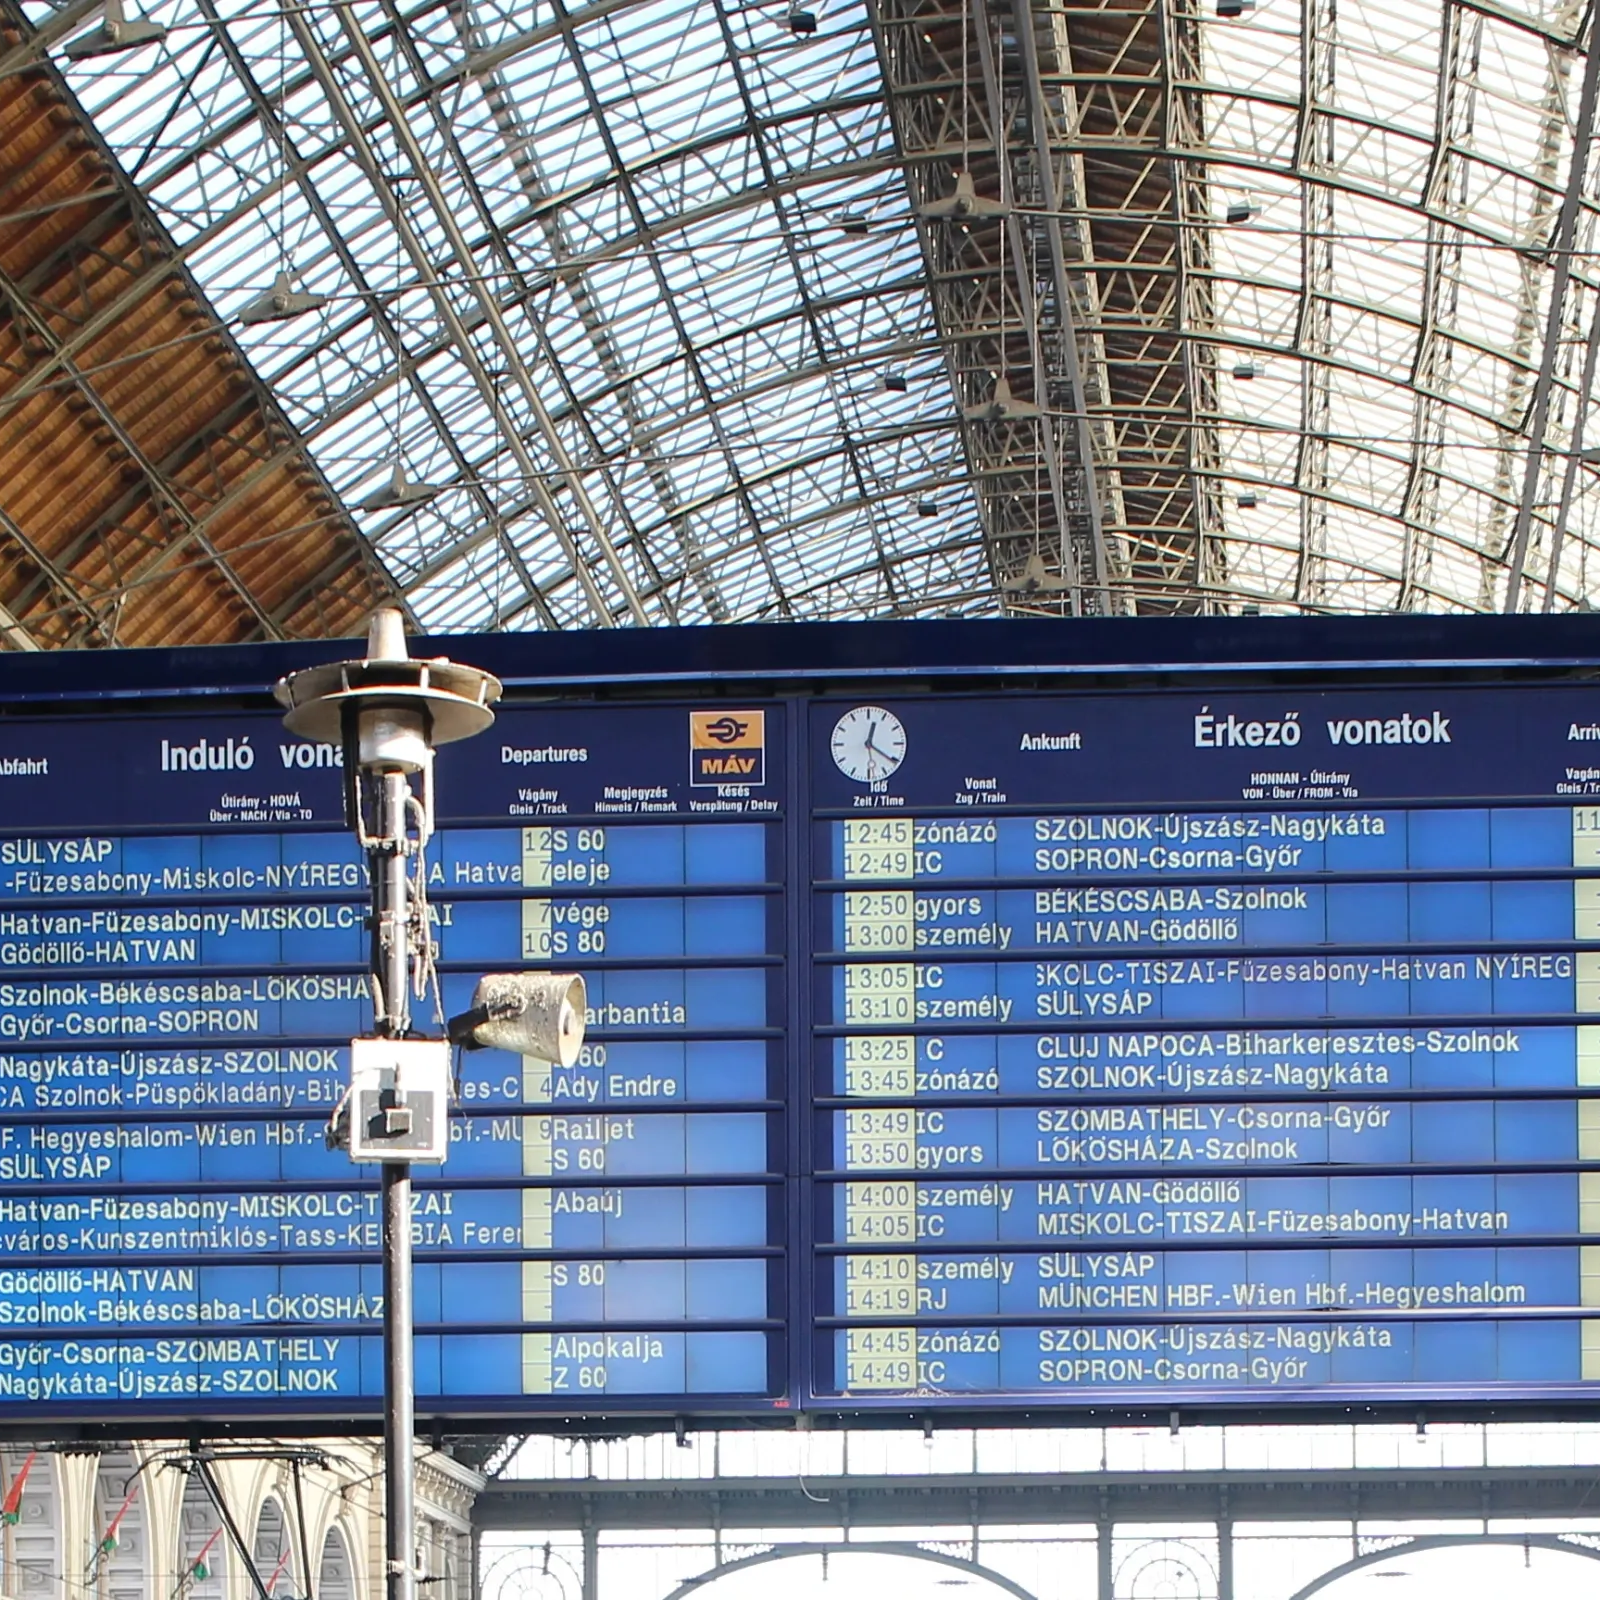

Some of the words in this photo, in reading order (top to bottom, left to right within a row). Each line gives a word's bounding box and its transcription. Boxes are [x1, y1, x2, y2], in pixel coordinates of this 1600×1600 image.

[1194, 706, 1301, 748] Érkező
[1326, 711, 1451, 745] vonatok
[1019, 732, 1082, 751] Ankunft
[161, 736, 255, 772] Induló
[500, 746, 588, 766] Departures
[701, 754, 756, 775] MÁV
[965, 777, 997, 790] Vonat
[1250, 772, 1299, 786] HONNAN
[1310, 769, 1350, 787] Útirány
[1556, 782, 1582, 794] Gleis
[518, 788, 558, 806] Vágány
[604, 785, 668, 802] Megjegyzés
[717, 783, 750, 798] Késés
[955, 793, 973, 806] Zug
[982, 792, 1006, 804] Train
[1242, 788, 1264, 800] VON
[1272, 786, 1296, 799] Über
[1304, 787, 1334, 799] FROM
[1342, 787, 1358, 798] Via
[221, 793, 260, 811] Útirány
[269, 792, 301, 807] HOVÁ
[509, 802, 534, 815] Gleis
[542, 802, 568, 814] Track
[595, 802, 632, 813] Hinweis
[641, 801, 678, 813] Remark
[689, 799, 742, 814] Verspätung
[750, 799, 778, 812] Delay
[853, 796, 873, 808] Zeit
[880, 795, 904, 807] Time
[210, 809, 232, 823] Über
[240, 809, 268, 822] NACH
[274, 809, 291, 820] Via
[299, 809, 312, 820] TO
[846, 822, 907, 844] 12:45
[914, 822, 997, 844] zónázó
[1035, 813, 1385, 844] SZOLNOK-Újszász-Nagykáta
[1574, 810, 1600, 832] 11
[1, 836, 112, 864] SÜLYSÁP
[525, 831, 550, 852] 12
[552, 830, 568, 851] S
[578, 829, 605, 851] 60
[846, 852, 907, 873] 12:49
[914, 851, 943, 874] IC
[1035, 844, 1302, 875] SOPRON-Csorna-Győr
[846, 895, 908, 917] 12:50
[915, 897, 982, 921] gyors
[1036, 887, 1307, 915] BÉKÉSCSABA-Szolnok
[846, 925, 908, 946] 13:00
[915, 923, 1012, 950] személy
[1036, 918, 1238, 944] HATVAN-Gödöllő
[1, 938, 196, 966] Gödöllő-HATVAN
[525, 932, 550, 953] 10
[552, 932, 568, 953] S
[578, 931, 605, 952] 80
[1, 1009, 259, 1041] Győr-Csorna-SOPRON
[0, 1151, 111, 1180] SÜLYSÁP
[554, 1150, 569, 1170] S
[578, 1148, 605, 1170] 60
[847, 1142, 909, 1164] 13:50
[916, 1145, 984, 1170] gyors
[847, 1216, 910, 1237] 14:05
[917, 1215, 945, 1237] IC
[1038, 1208, 1508, 1236] MISKOLC-TISZAI-Füzesabony-Hatvan
[553, 1265, 568, 1286] S
[578, 1264, 605, 1286] 80
[848, 1288, 910, 1310] 14:19
[917, 1287, 947, 1310] RJ
[1039, 1282, 1157, 1309] MÜNCHEN
[1168, 1282, 1296, 1307] HBF.-Wien
[1306, 1281, 1525, 1308] Hbf.-Hegyeshalom
[554, 1335, 664, 1363] Alpokalja
[554, 1367, 569, 1388] Z
[578, 1366, 606, 1388] 60
[848, 1361, 911, 1383] 14:49
[918, 1360, 946, 1382] IC
[1039, 1356, 1308, 1385] SOPRON-Csorna-Győr
